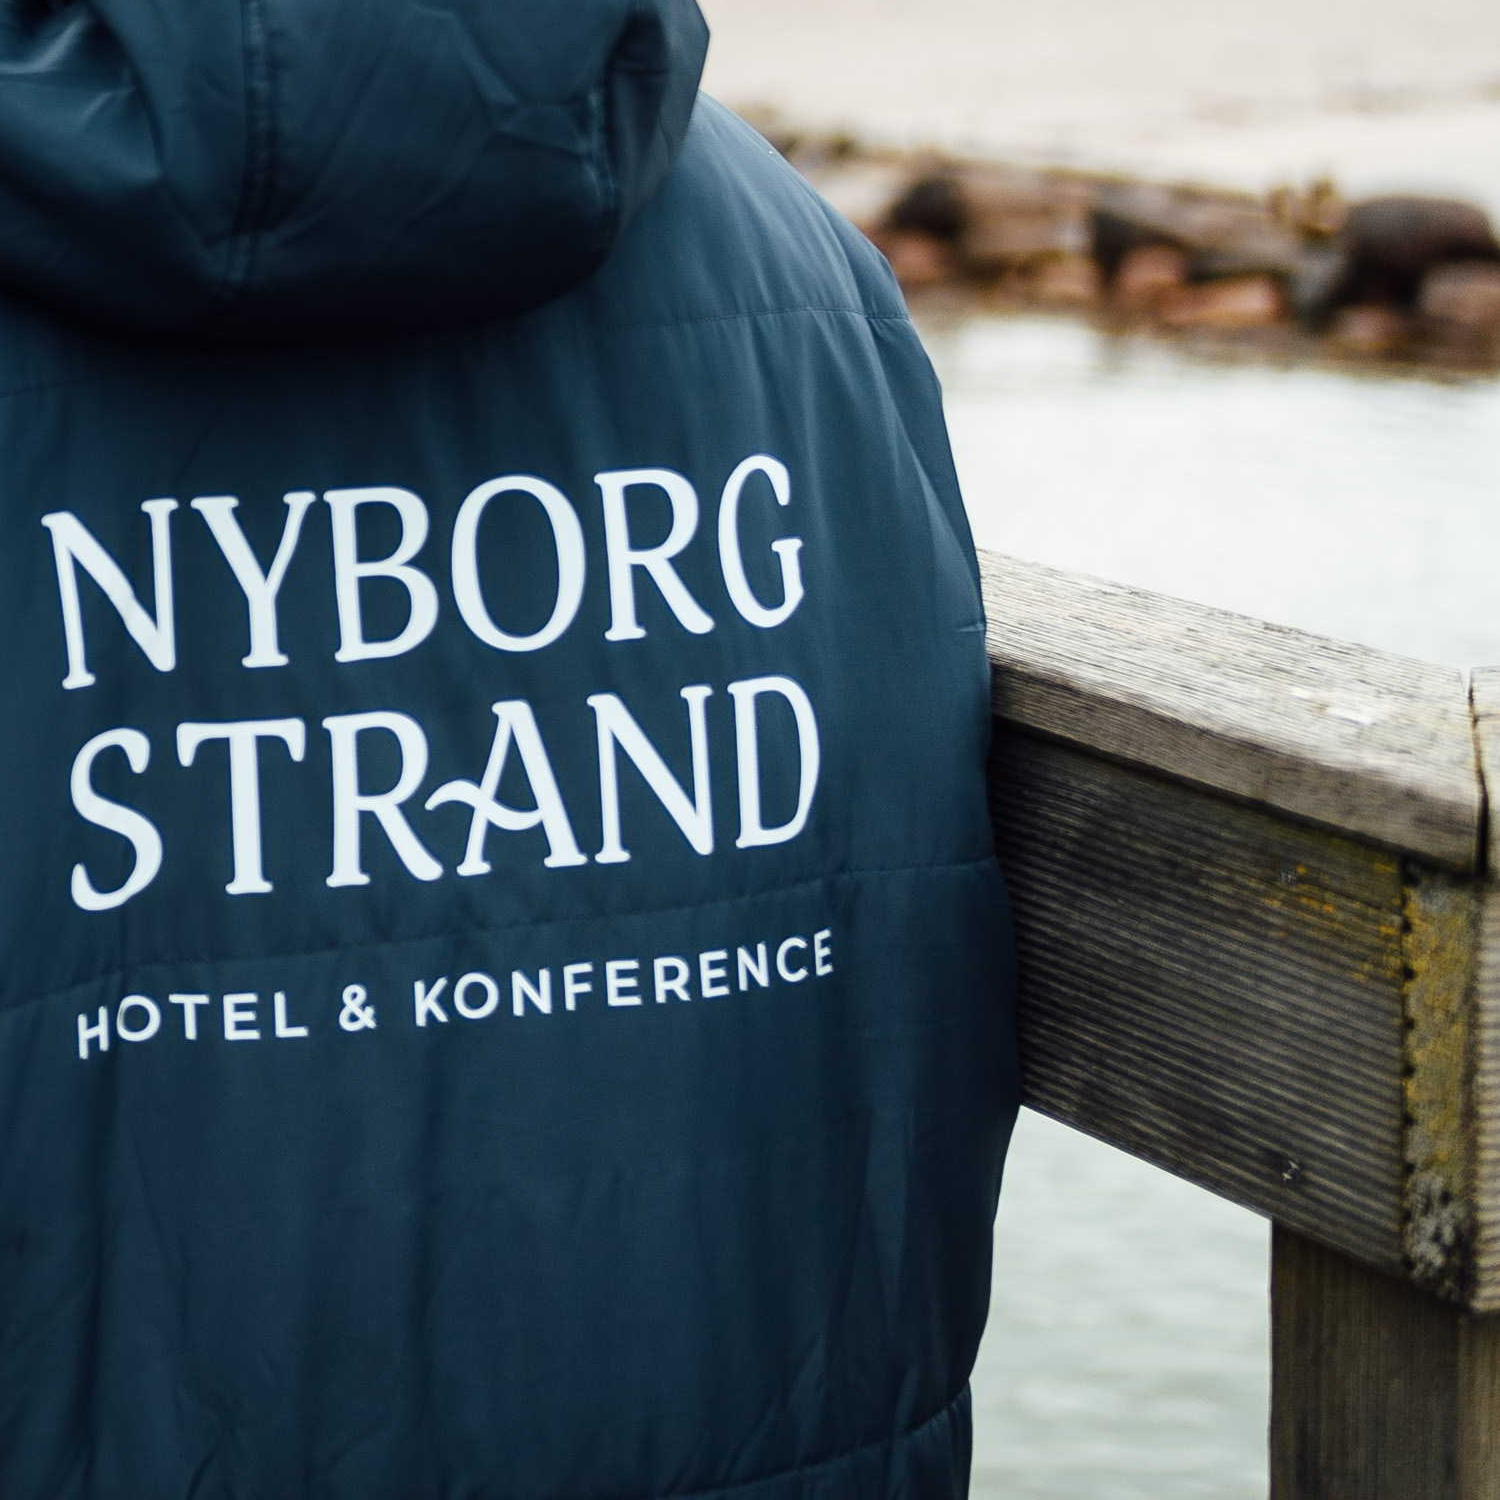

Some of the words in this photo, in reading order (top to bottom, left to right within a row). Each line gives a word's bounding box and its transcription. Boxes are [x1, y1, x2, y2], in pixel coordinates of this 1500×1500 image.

[41, 454, 804, 689] NYBORG
[71, 676, 820, 910] STRAND
[78, 991, 308, 1059] HOTEL
[339, 985, 377, 1032] &
[415, 930, 833, 1026] KONFERENCE
